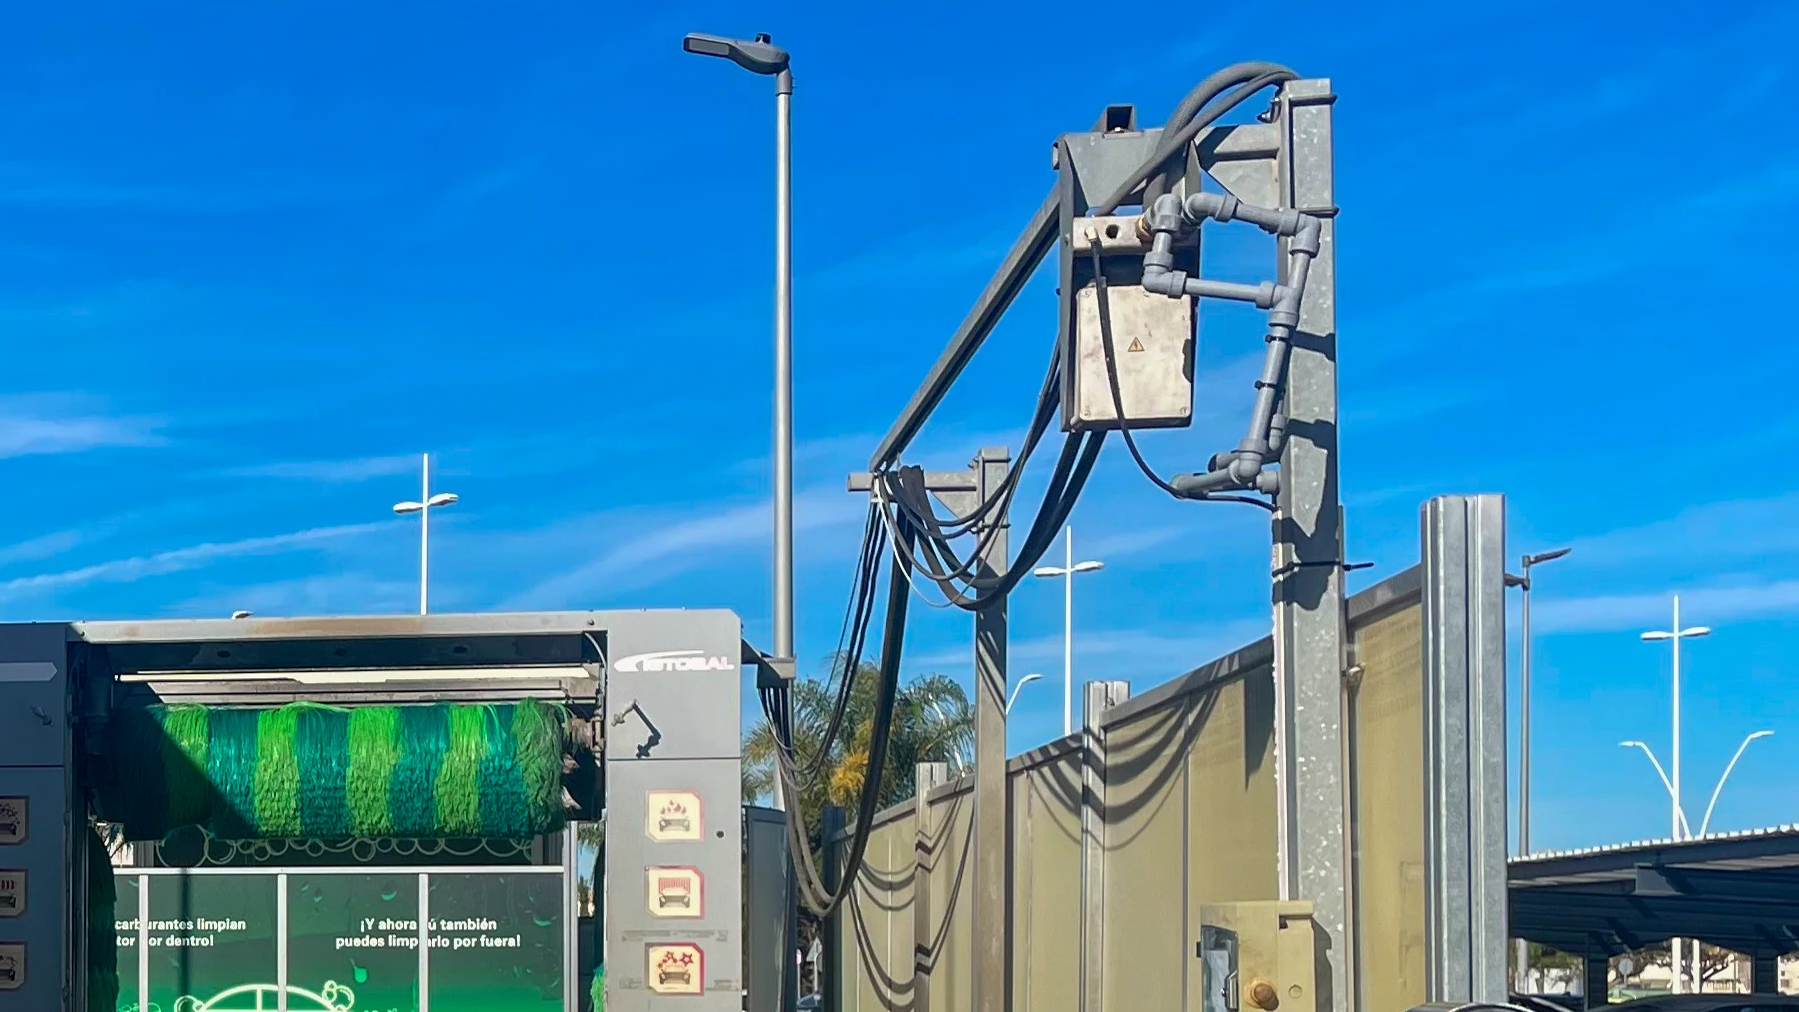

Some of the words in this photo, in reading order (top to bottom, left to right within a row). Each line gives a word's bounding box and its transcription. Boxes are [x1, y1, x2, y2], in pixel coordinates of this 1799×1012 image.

[196, 918, 247, 933] limpian
[378, 917, 418, 931] ahora
[440, 917, 498, 931] también
[165, 934, 215, 947] dentro!
[335, 935, 386, 950] puedes
[453, 936, 477, 950] por
[480, 934, 521, 948] fuera!
